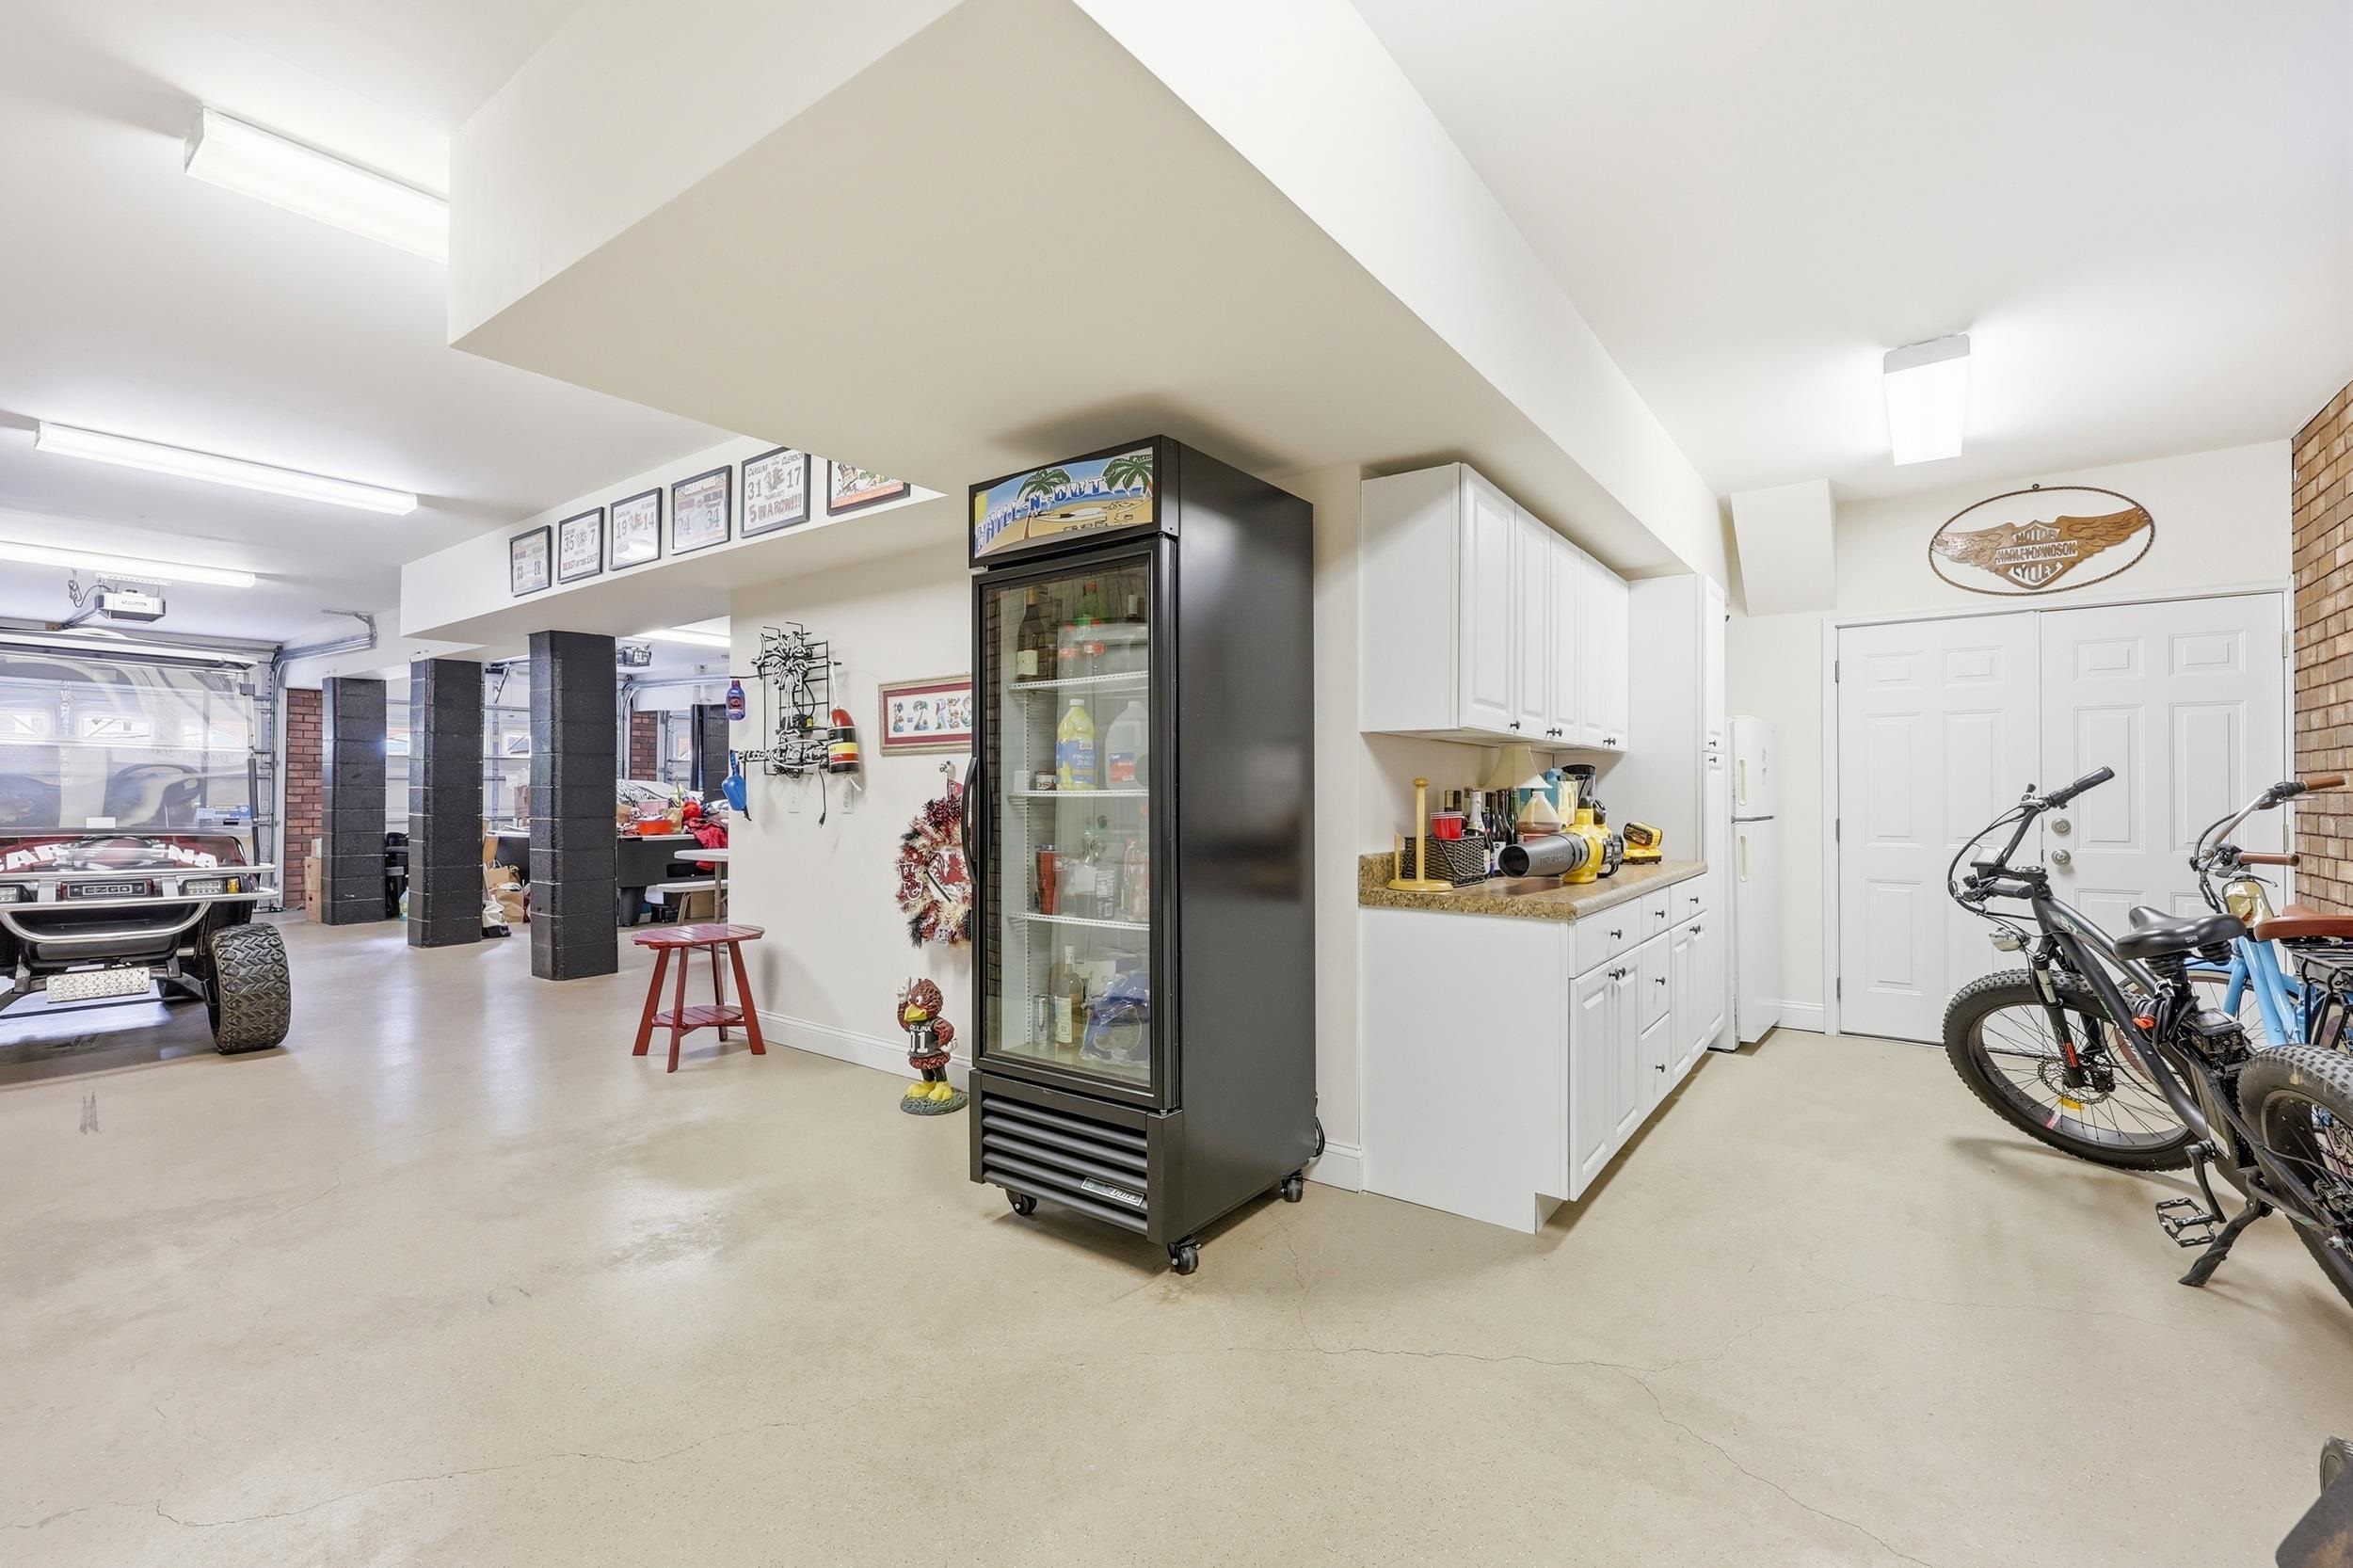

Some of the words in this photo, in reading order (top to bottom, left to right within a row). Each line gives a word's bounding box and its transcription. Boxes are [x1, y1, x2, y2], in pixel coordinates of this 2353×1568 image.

[747, 478, 762, 500] 31
[787, 466, 802, 488] 17
[706, 507, 721, 530] 34
[590, 528, 596, 546] 7
